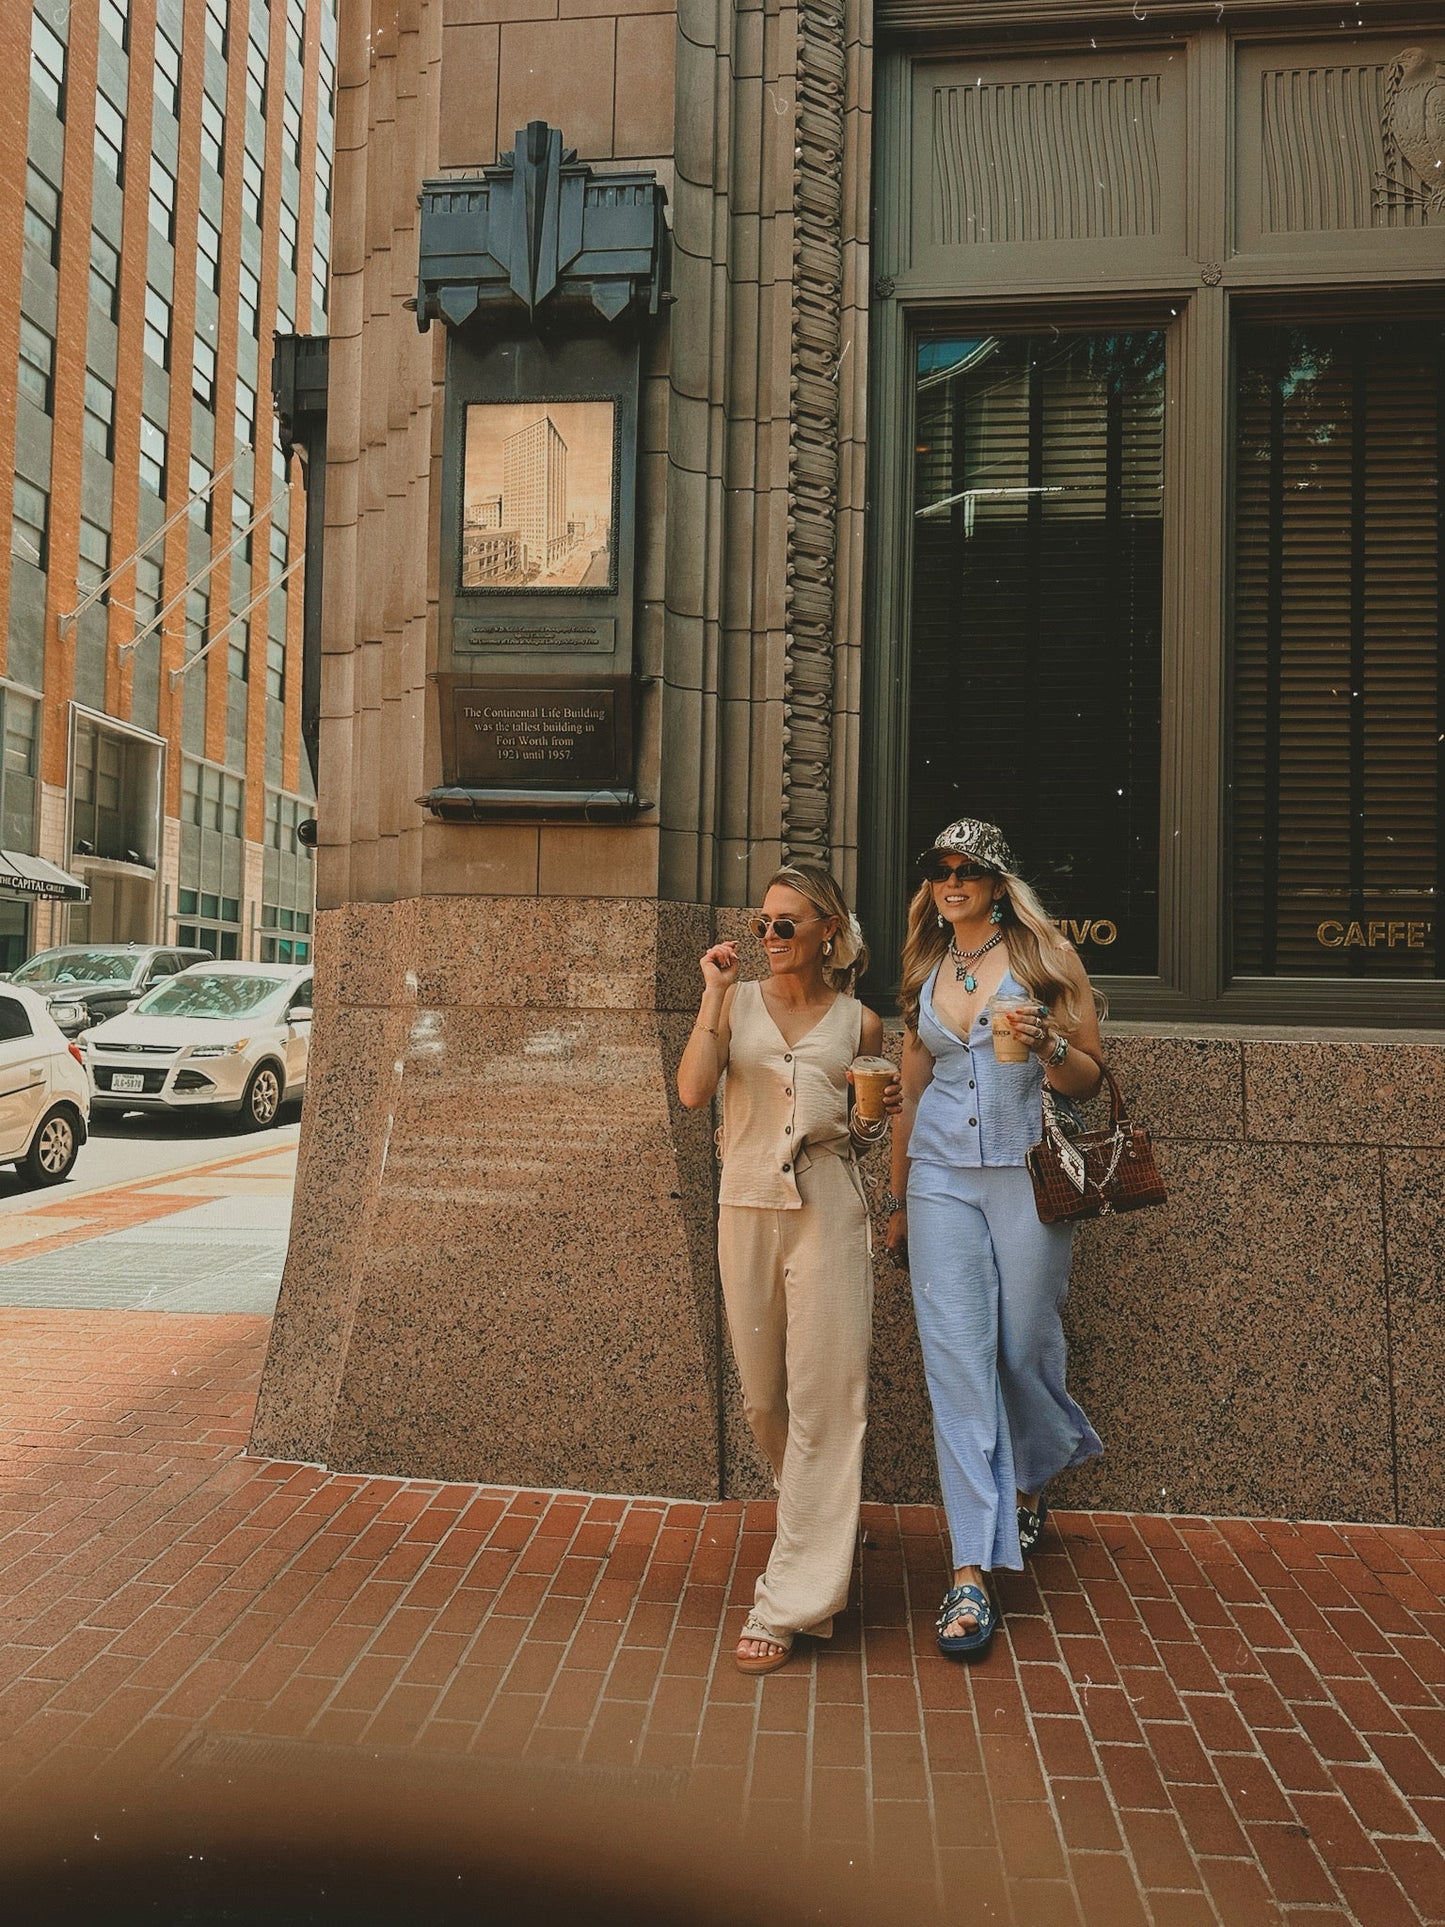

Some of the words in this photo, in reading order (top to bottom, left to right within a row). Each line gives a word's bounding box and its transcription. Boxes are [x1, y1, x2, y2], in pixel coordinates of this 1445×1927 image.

[464, 707, 481, 718] The
[484, 707, 538, 718] Continental
[541, 708, 561, 718] Life
[564, 708, 605, 720] Building
[474, 723, 493, 731] was
[496, 722, 509, 732] the
[512, 722, 541, 732] tallest
[543, 722, 583, 734] building
[585, 723, 595, 732] in
[496, 736, 515, 746] Fort
[518, 736, 548, 746] Worth
[551, 736, 574, 746] from
[523, 750, 544, 760] until
[12, 877, 46, 892] CAPITAL
[1316, 920, 1432, 947] CAFFE'
